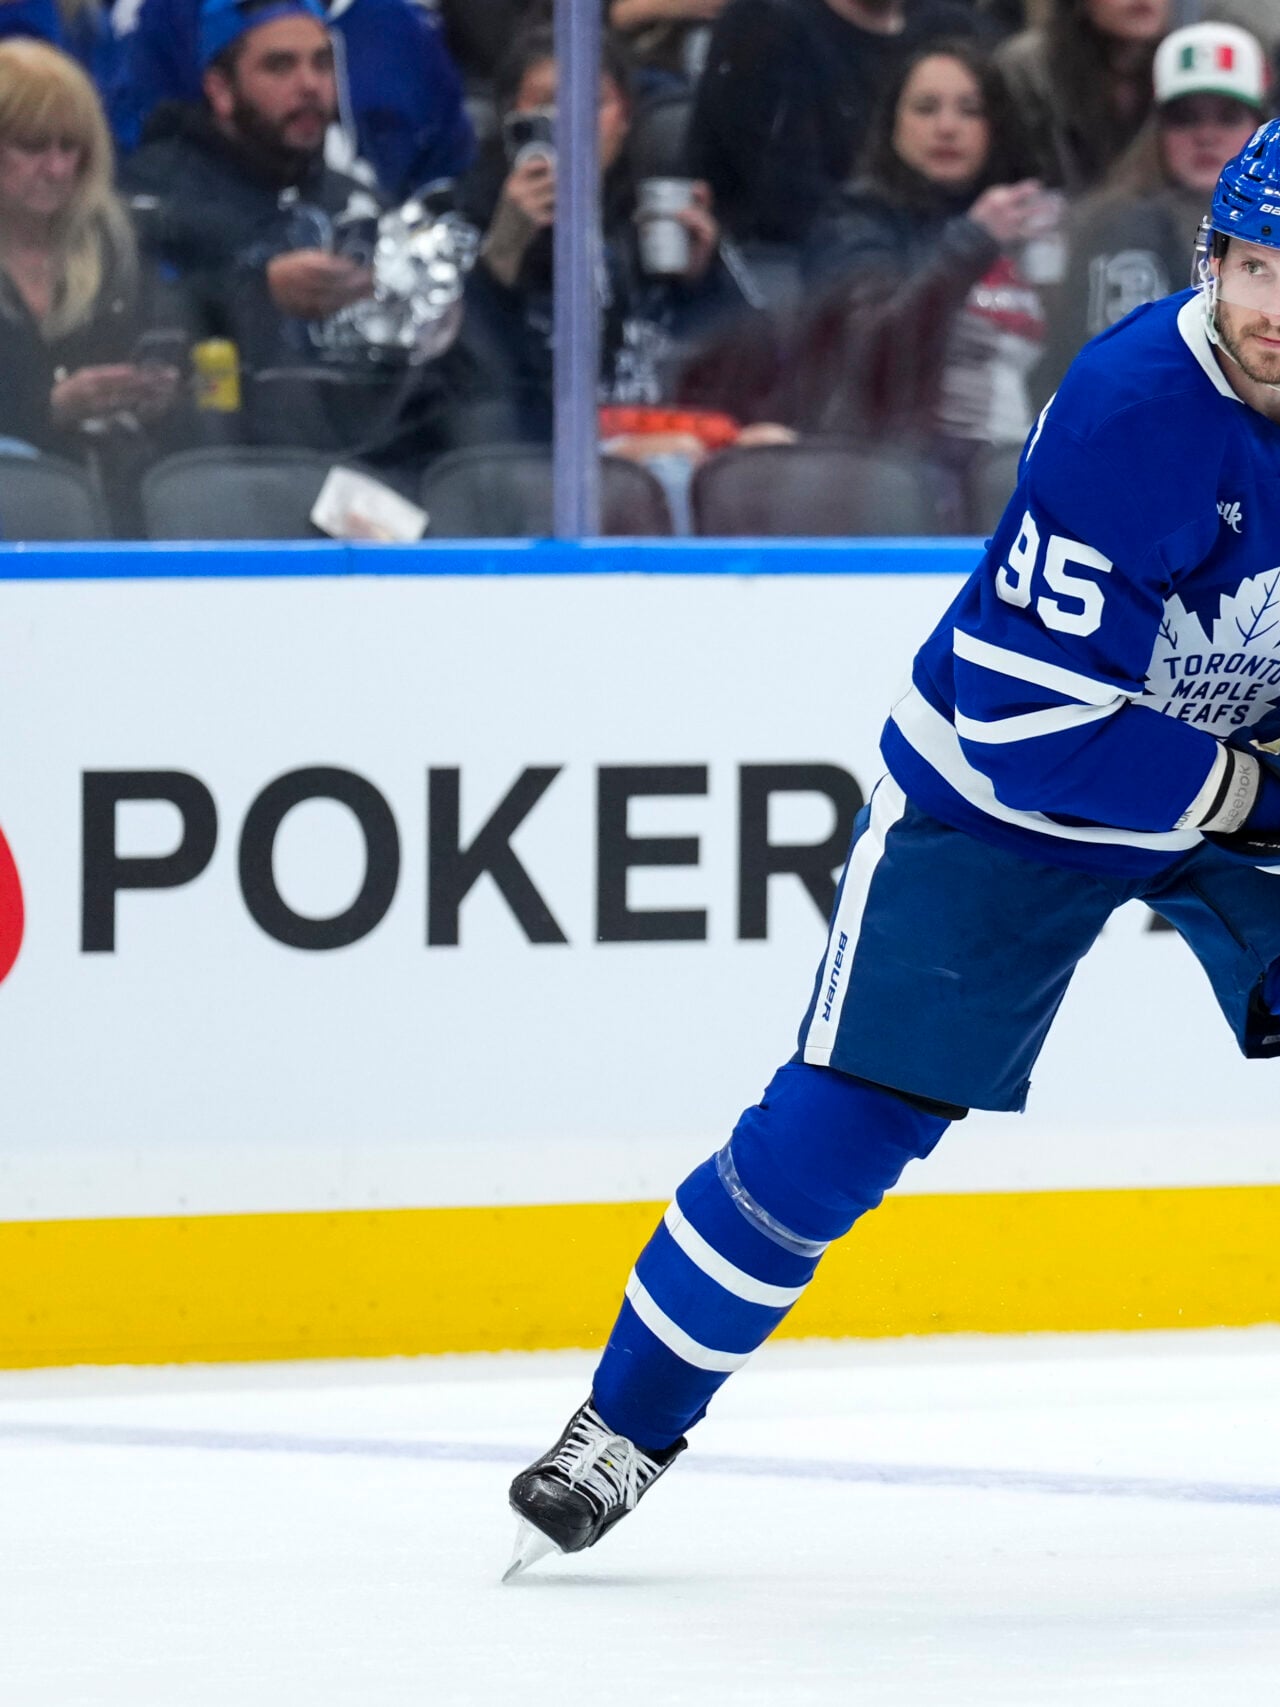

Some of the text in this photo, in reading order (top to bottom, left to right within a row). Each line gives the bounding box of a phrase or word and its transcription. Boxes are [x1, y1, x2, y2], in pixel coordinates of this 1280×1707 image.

[995, 510, 1114, 638] 95
[1171, 679, 1264, 701] MAPLE
[1221, 764, 1251, 827] Reebok
[822, 931, 848, 1022] BAUER
